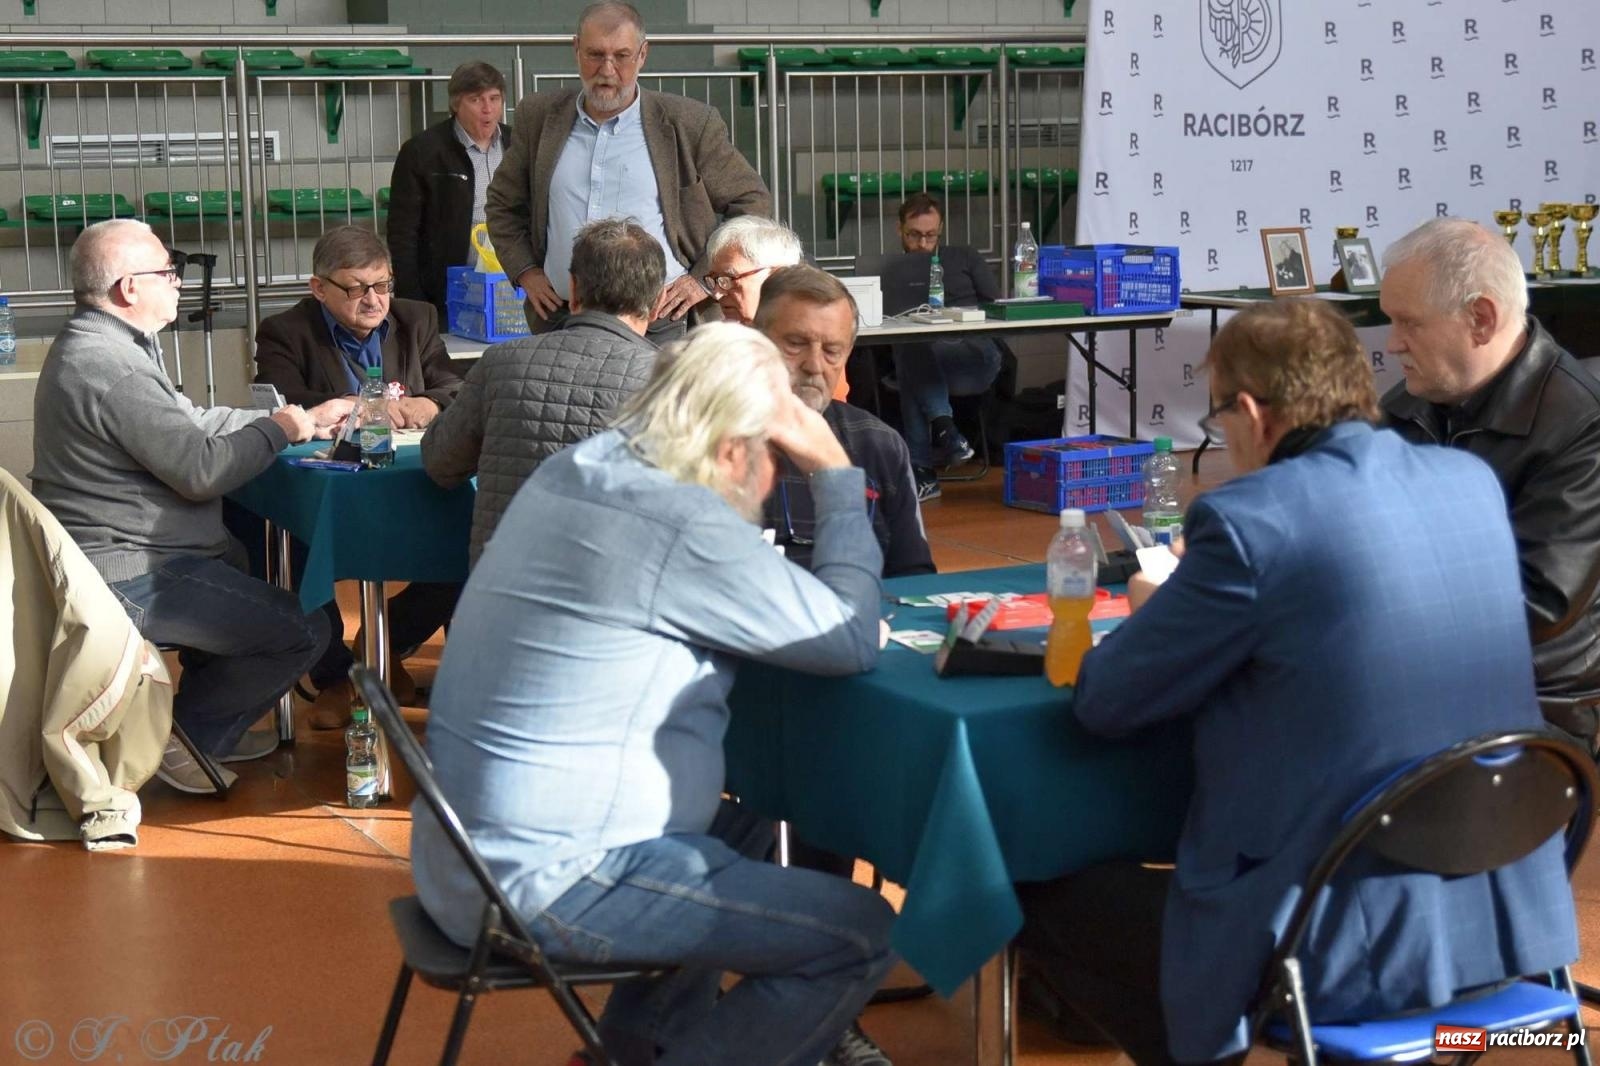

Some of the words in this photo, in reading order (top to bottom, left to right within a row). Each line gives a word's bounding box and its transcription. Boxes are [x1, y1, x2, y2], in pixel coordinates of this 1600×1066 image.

[1104, 9, 1115, 28] R
[1153, 14, 1163, 32] R
[1464, 18, 1478, 35] R
[1540, 14, 1554, 31] R
[1324, 21, 1337, 38] R
[1392, 20, 1405, 37] R
[1130, 52, 1140, 70] R
[1430, 56, 1444, 73] R
[1504, 52, 1519, 69] R
[1581, 48, 1596, 65] R
[1360, 58, 1373, 75] R
[1100, 91, 1113, 109] R
[1153, 93, 1163, 111] R
[1327, 95, 1340, 113] R
[1395, 94, 1409, 111] R
[1467, 91, 1481, 108] R
[1542, 87, 1557, 104] R
[1183, 105, 1306, 138] RACIBÓRZ
[1583, 121, 1597, 137] R
[1129, 132, 1139, 150] R
[1363, 132, 1376, 149] R
[1433, 129, 1447, 146] R
[1507, 125, 1521, 142] R
[1230, 159, 1254, 173] 1217
[1469, 164, 1483, 181] R
[1544, 159, 1558, 176] R
[1095, 171, 1109, 190] R
[1153, 172, 1163, 190] R
[1329, 170, 1342, 186] R
[1398, 167, 1411, 184] R
[1236, 209, 1248, 227] R
[1299, 207, 1312, 225] R
[1365, 205, 1379, 222] R
[1435, 202, 1449, 218] R
[1129, 211, 1139, 229] R
[1180, 210, 1190, 228] R
[1207, 248, 1219, 265] R
[1154, 327, 1165, 345] R
[1371, 351, 1385, 367] R
[1182, 363, 1194, 381] R
[1077, 404, 1091, 422] R
[1151, 403, 1165, 420] R
